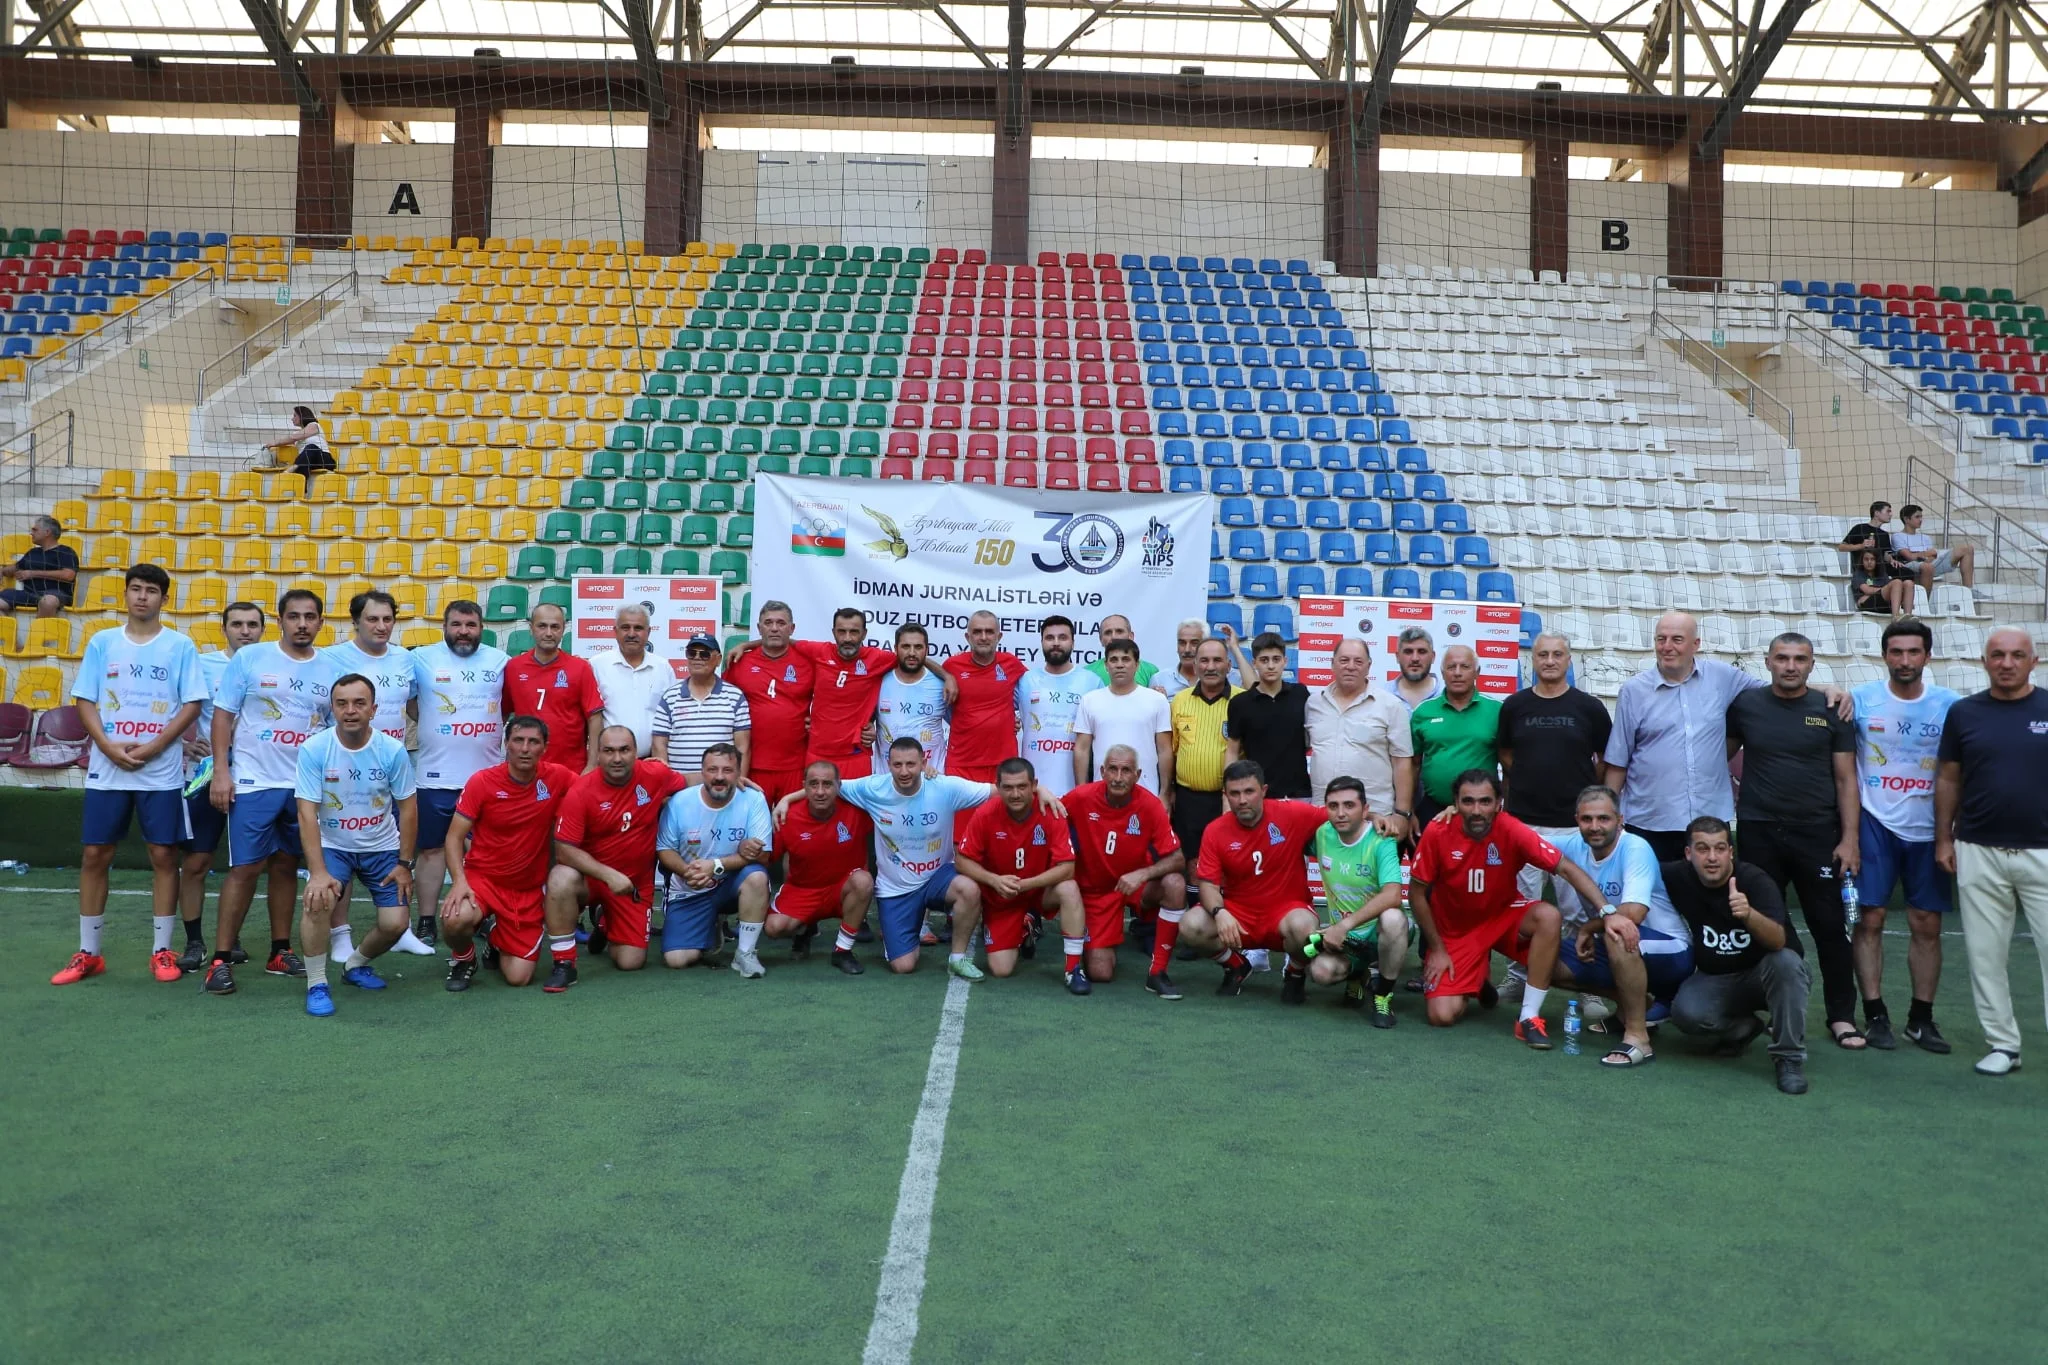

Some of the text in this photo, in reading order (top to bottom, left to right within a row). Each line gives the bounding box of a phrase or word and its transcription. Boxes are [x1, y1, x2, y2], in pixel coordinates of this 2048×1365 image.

[388, 184, 421, 214] A
[1602, 220, 1630, 251] B
[796, 500, 844, 511] AZERBAIJAN
[974, 538, 1016, 566] 150
[1142, 554, 1174, 567] AIPS
[853, 577, 1103, 606] İDMAN JURNALİSTLƏRİ VƏ
[905, 612, 970, 630] FUTBO
[536, 688, 546, 710] 7
[767, 679, 777, 698] 4
[1525, 716, 1576, 727] LACOSTE
[621, 811, 632, 832] 3
[1105, 830, 1117, 855] 6
[1015, 847, 1025, 869] 8
[1252, 850, 1263, 875] 2
[1468, 868, 1485, 893] 10
[1703, 925, 1751, 950] D&G
